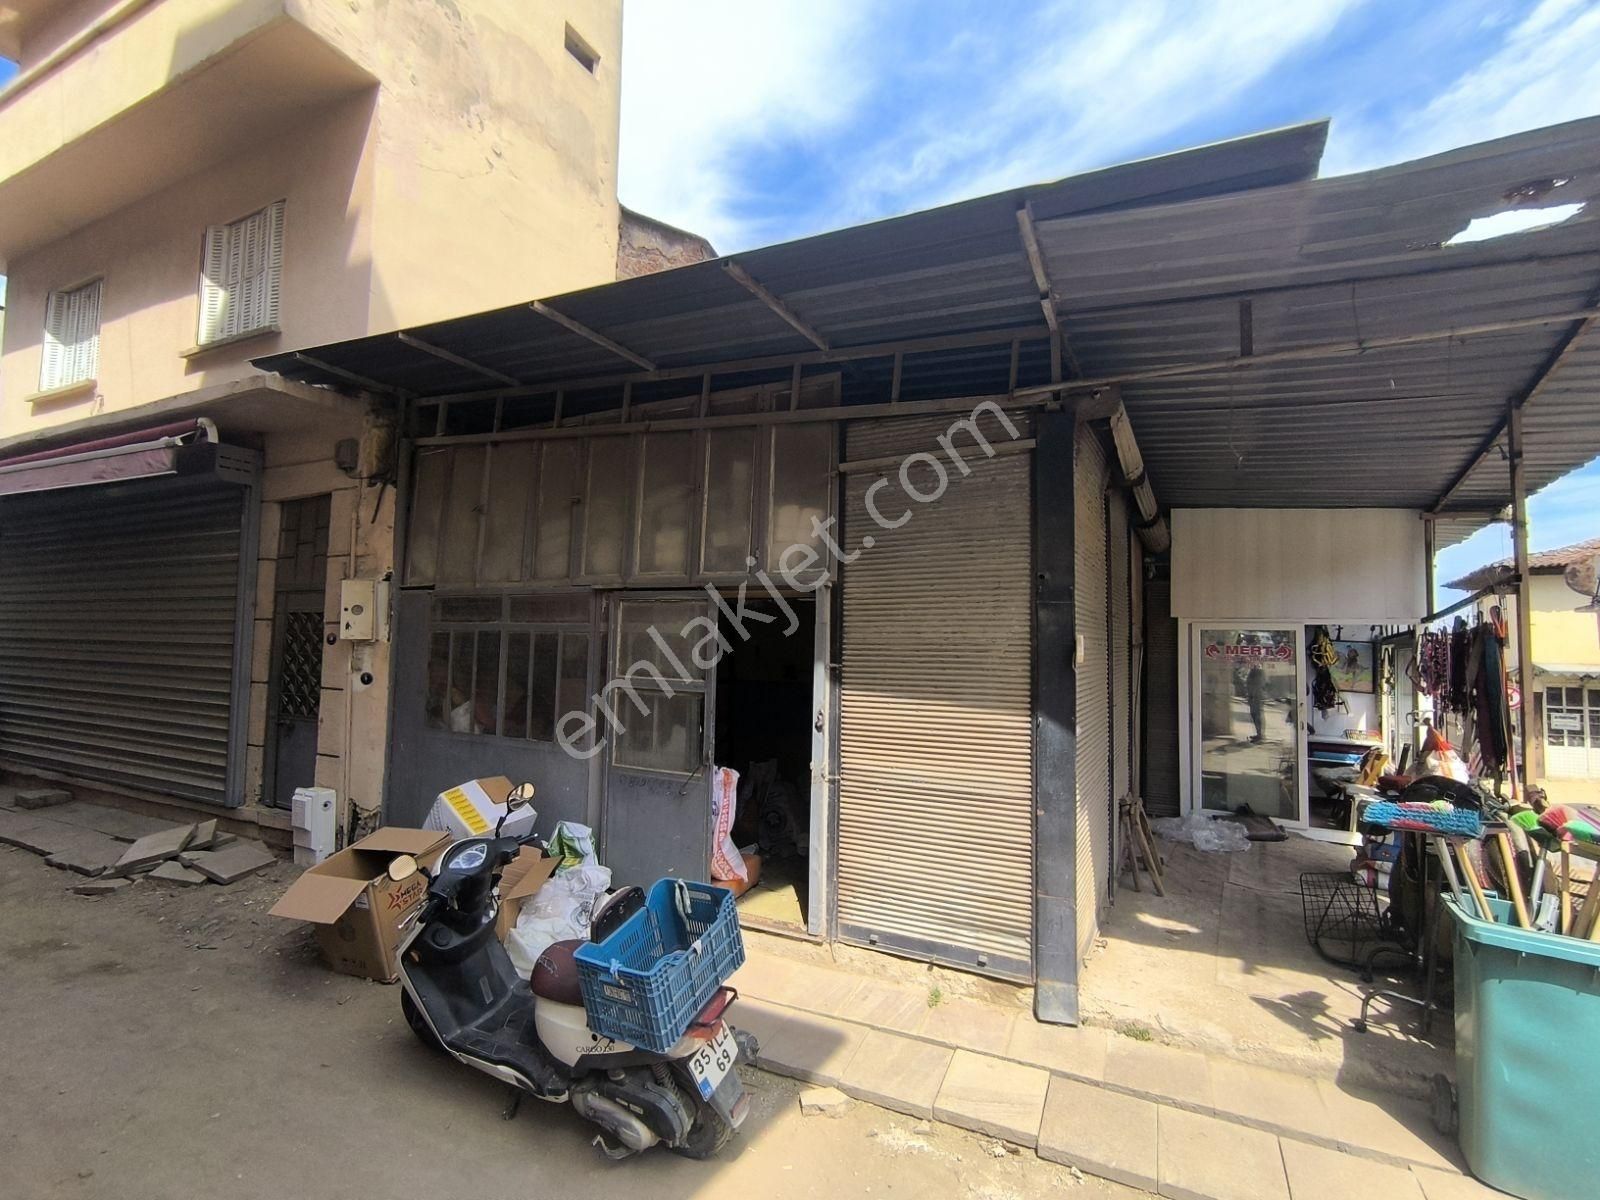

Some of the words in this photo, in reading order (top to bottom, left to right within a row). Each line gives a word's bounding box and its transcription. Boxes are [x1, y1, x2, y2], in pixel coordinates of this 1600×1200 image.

[1226, 645, 1274, 655] MERT
[694, 1049, 711, 1075] 35
[717, 1049, 731, 1072] 69
